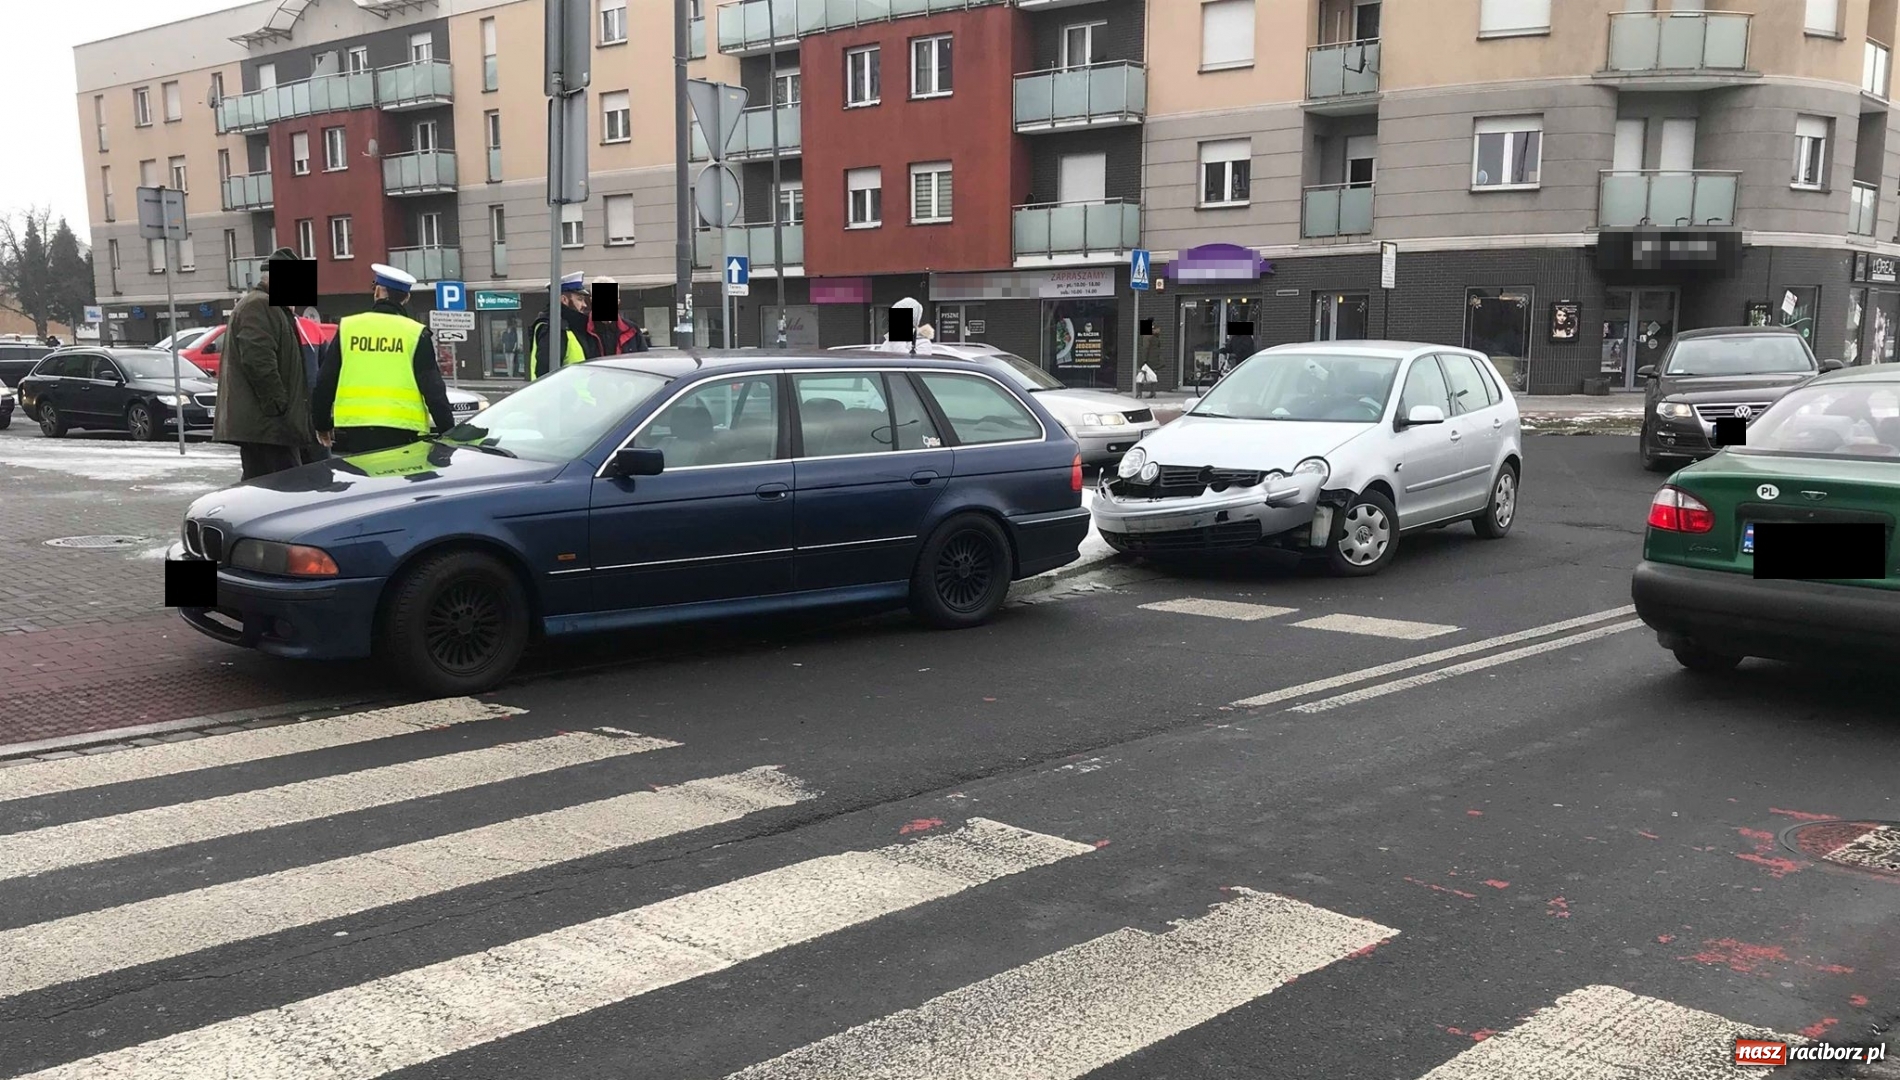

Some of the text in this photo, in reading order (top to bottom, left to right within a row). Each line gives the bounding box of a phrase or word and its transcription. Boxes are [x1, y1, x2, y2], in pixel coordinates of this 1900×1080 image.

[443, 285, 460, 309] P
[350, 335, 404, 353] POLICJA
[1761, 486, 1776, 497] PL
